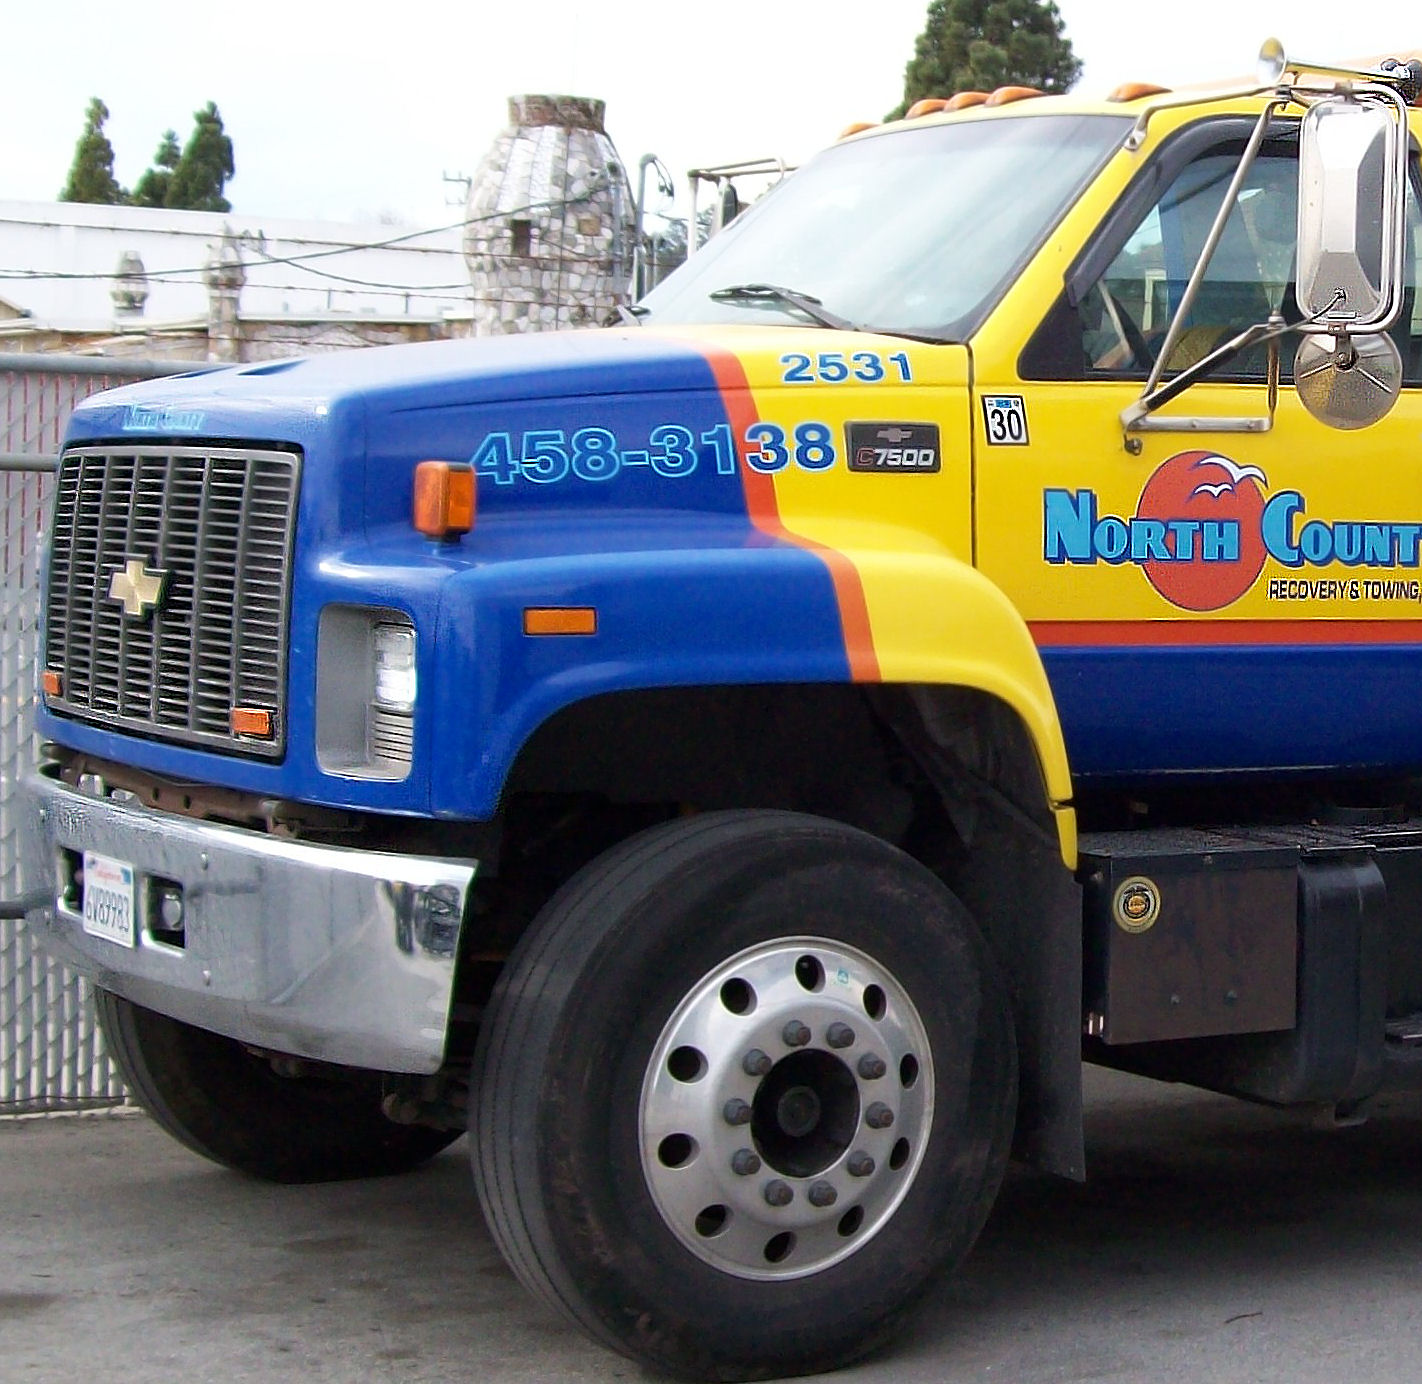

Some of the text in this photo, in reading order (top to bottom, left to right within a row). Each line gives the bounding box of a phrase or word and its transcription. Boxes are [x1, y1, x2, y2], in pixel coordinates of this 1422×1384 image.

[780, 351, 913, 384] 2531
[991, 409, 1022, 440] 30
[470, 421, 837, 485] 458-3138
[857, 448, 934, 467] C7500
[1043, 488, 1243, 565] NORTH
[1269, 580, 1346, 600] RECOVERY
[1349, 580, 1360, 600] &
[1363, 580, 1422, 603] TOWING,
